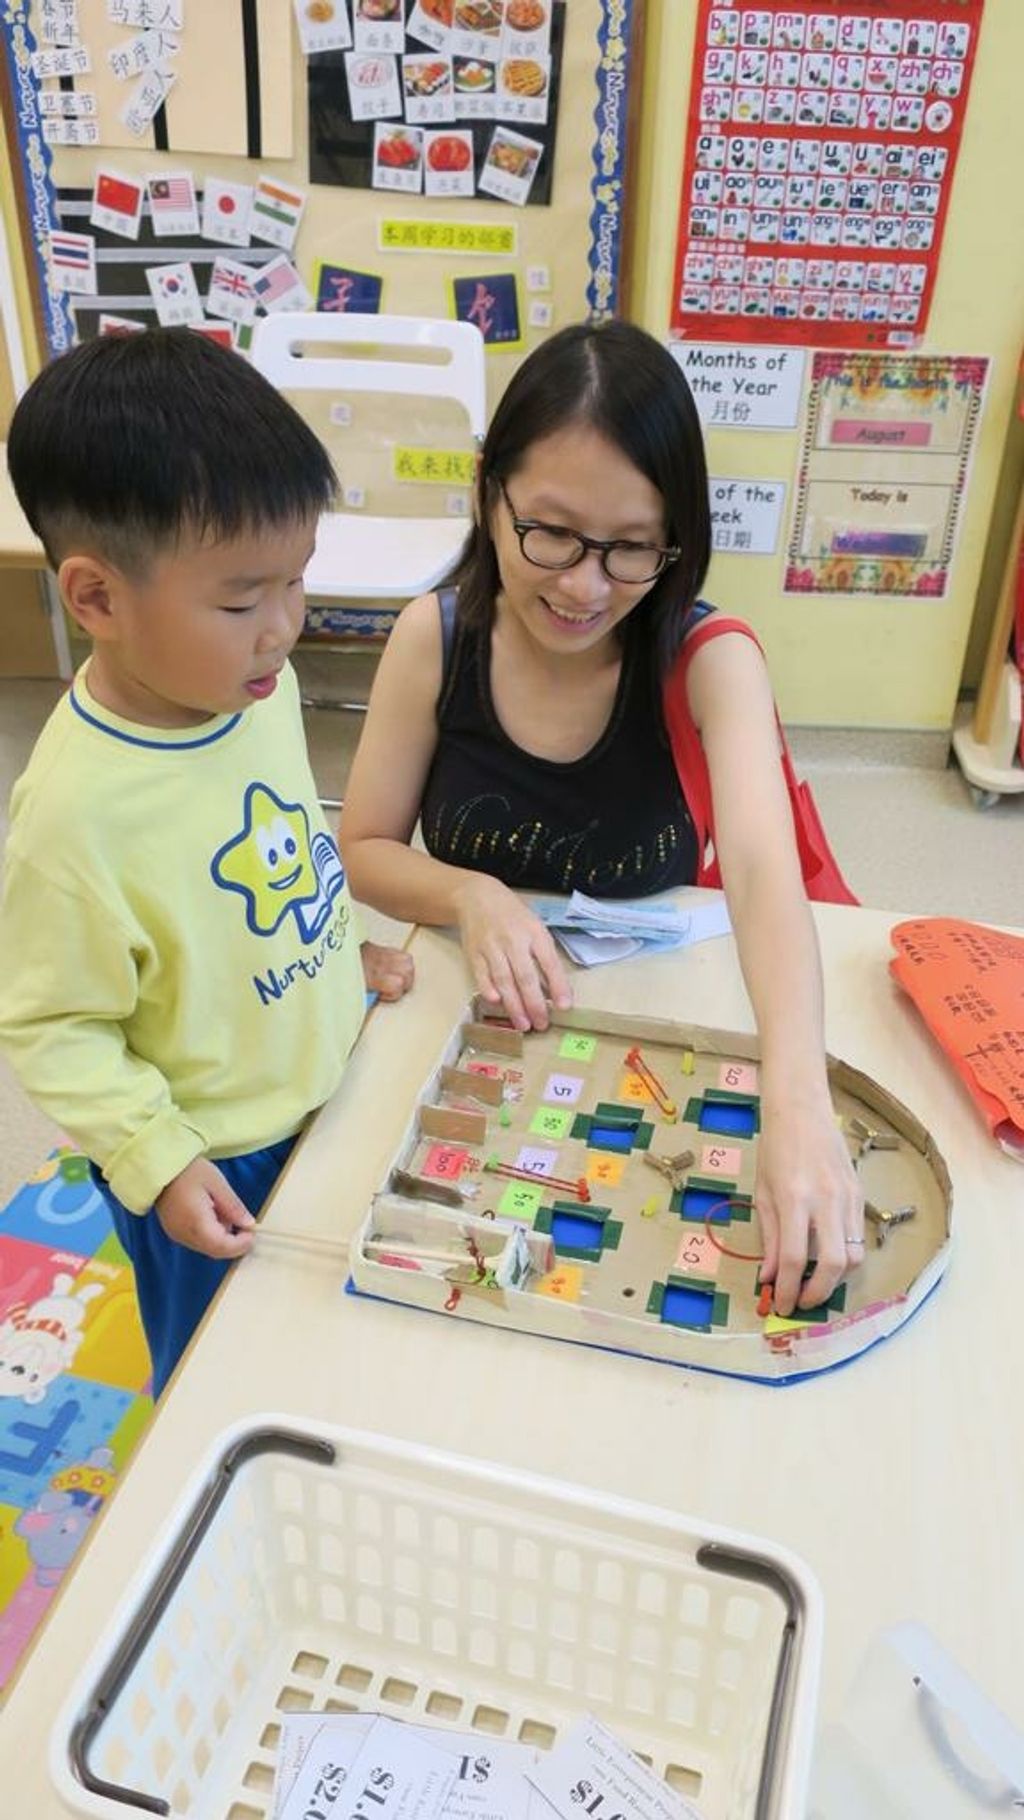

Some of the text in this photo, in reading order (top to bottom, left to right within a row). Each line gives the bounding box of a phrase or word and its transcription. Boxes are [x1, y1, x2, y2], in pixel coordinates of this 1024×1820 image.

[686, 350, 788, 371] Months of
[691, 375, 778, 396] the Year
[712, 400, 752, 421] 月份
[399, 452, 474, 480] 我来找
[715, 483, 775, 502] of the
[851, 487, 893, 506] Today
[711, 508, 742, 523] eek
[715, 530, 752, 548] 日期
[724, 1066, 743, 1087] 20
[553, 1085, 573, 1097] 5
[708, 1147, 727, 1168] 20
[682, 1235, 706, 1266] 20
